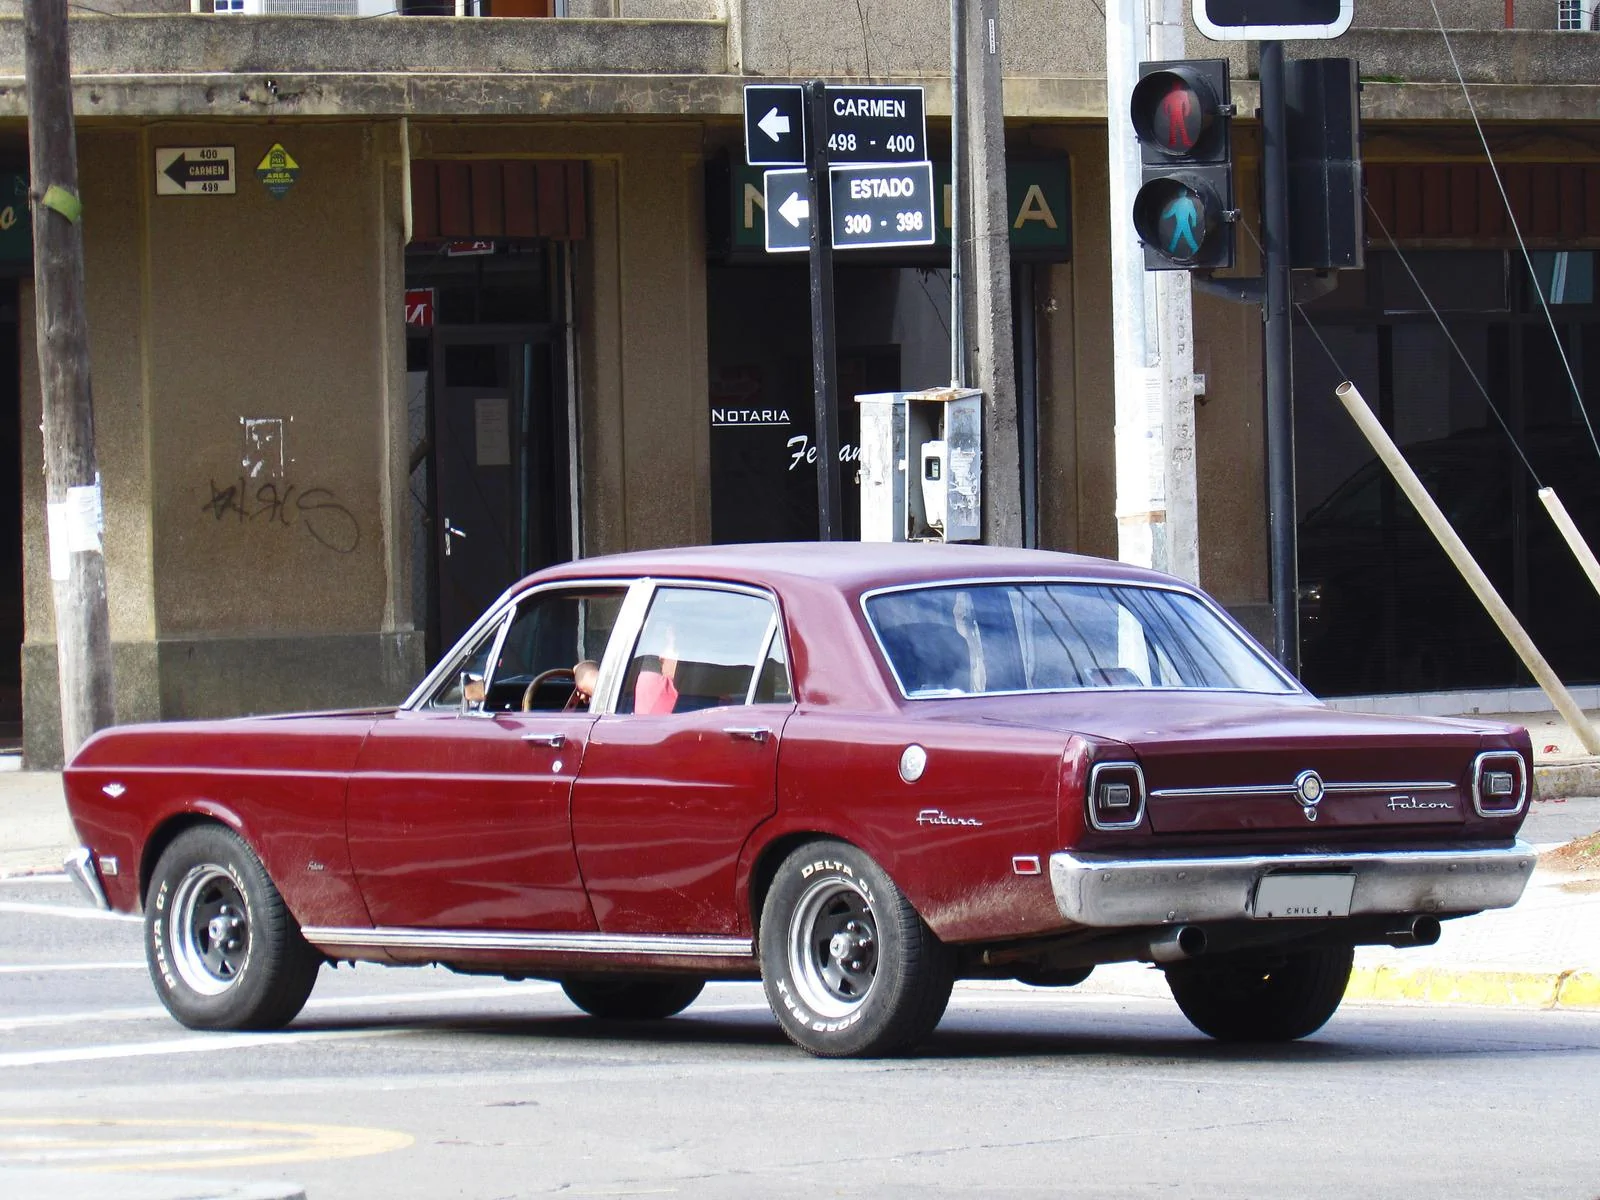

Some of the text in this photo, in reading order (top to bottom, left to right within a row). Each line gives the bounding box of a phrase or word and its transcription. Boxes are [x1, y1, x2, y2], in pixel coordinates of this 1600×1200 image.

[833, 98, 906, 118] CARMEN
[828, 133, 857, 151] 498
[886, 135, 915, 153] 400
[200, 149, 218, 159] 400
[189, 165, 225, 176] CARMEN
[201, 182, 219, 193] 499
[850, 177, 914, 199] ESTADO
[844, 214, 872, 235] 300
[895, 211, 923, 232] 398
[1387, 795, 1454, 811] Falcon
[915, 808, 983, 827] Futura
[801, 860, 876, 904] DELTA GT
[153, 879, 177, 990] DELTA GT
[775, 977, 810, 1025] MAX
